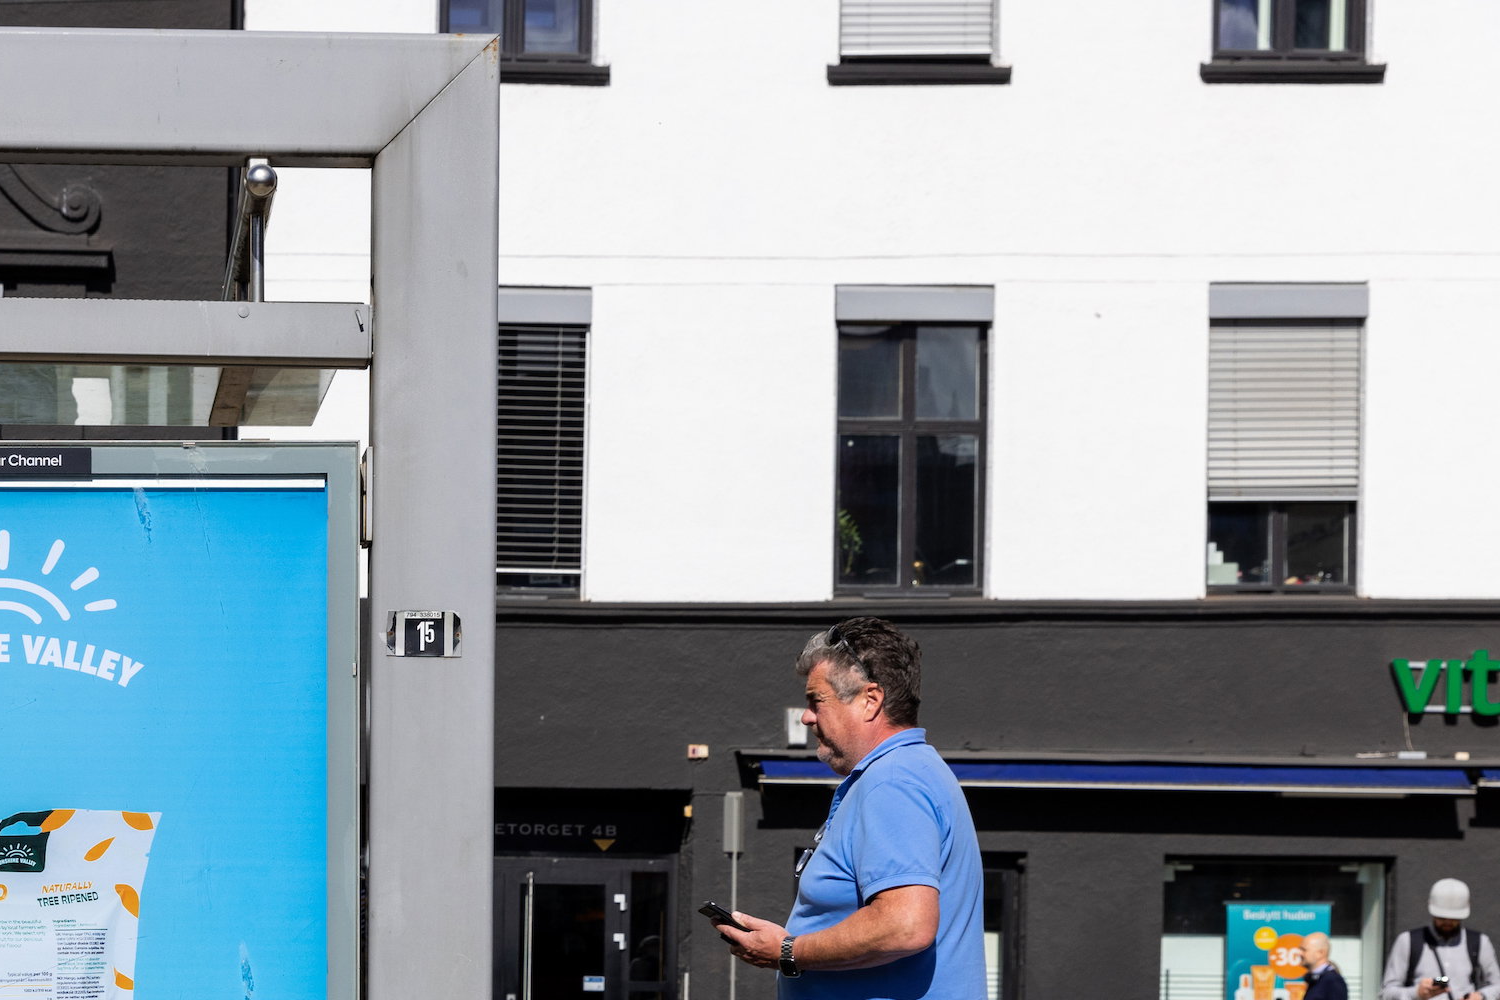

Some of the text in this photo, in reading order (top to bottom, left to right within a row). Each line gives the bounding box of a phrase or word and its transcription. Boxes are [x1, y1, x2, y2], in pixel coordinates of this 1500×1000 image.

[8, 453, 62, 467] Channel
[416, 621, 435, 652] 15
[22, 634, 144, 688] VALLEY
[1392, 649, 1500, 716] vit
[591, 824, 617, 836] 4B
[41, 881, 94, 894] NATURALLY
[37, 892, 99, 908] TREE RIPENED
